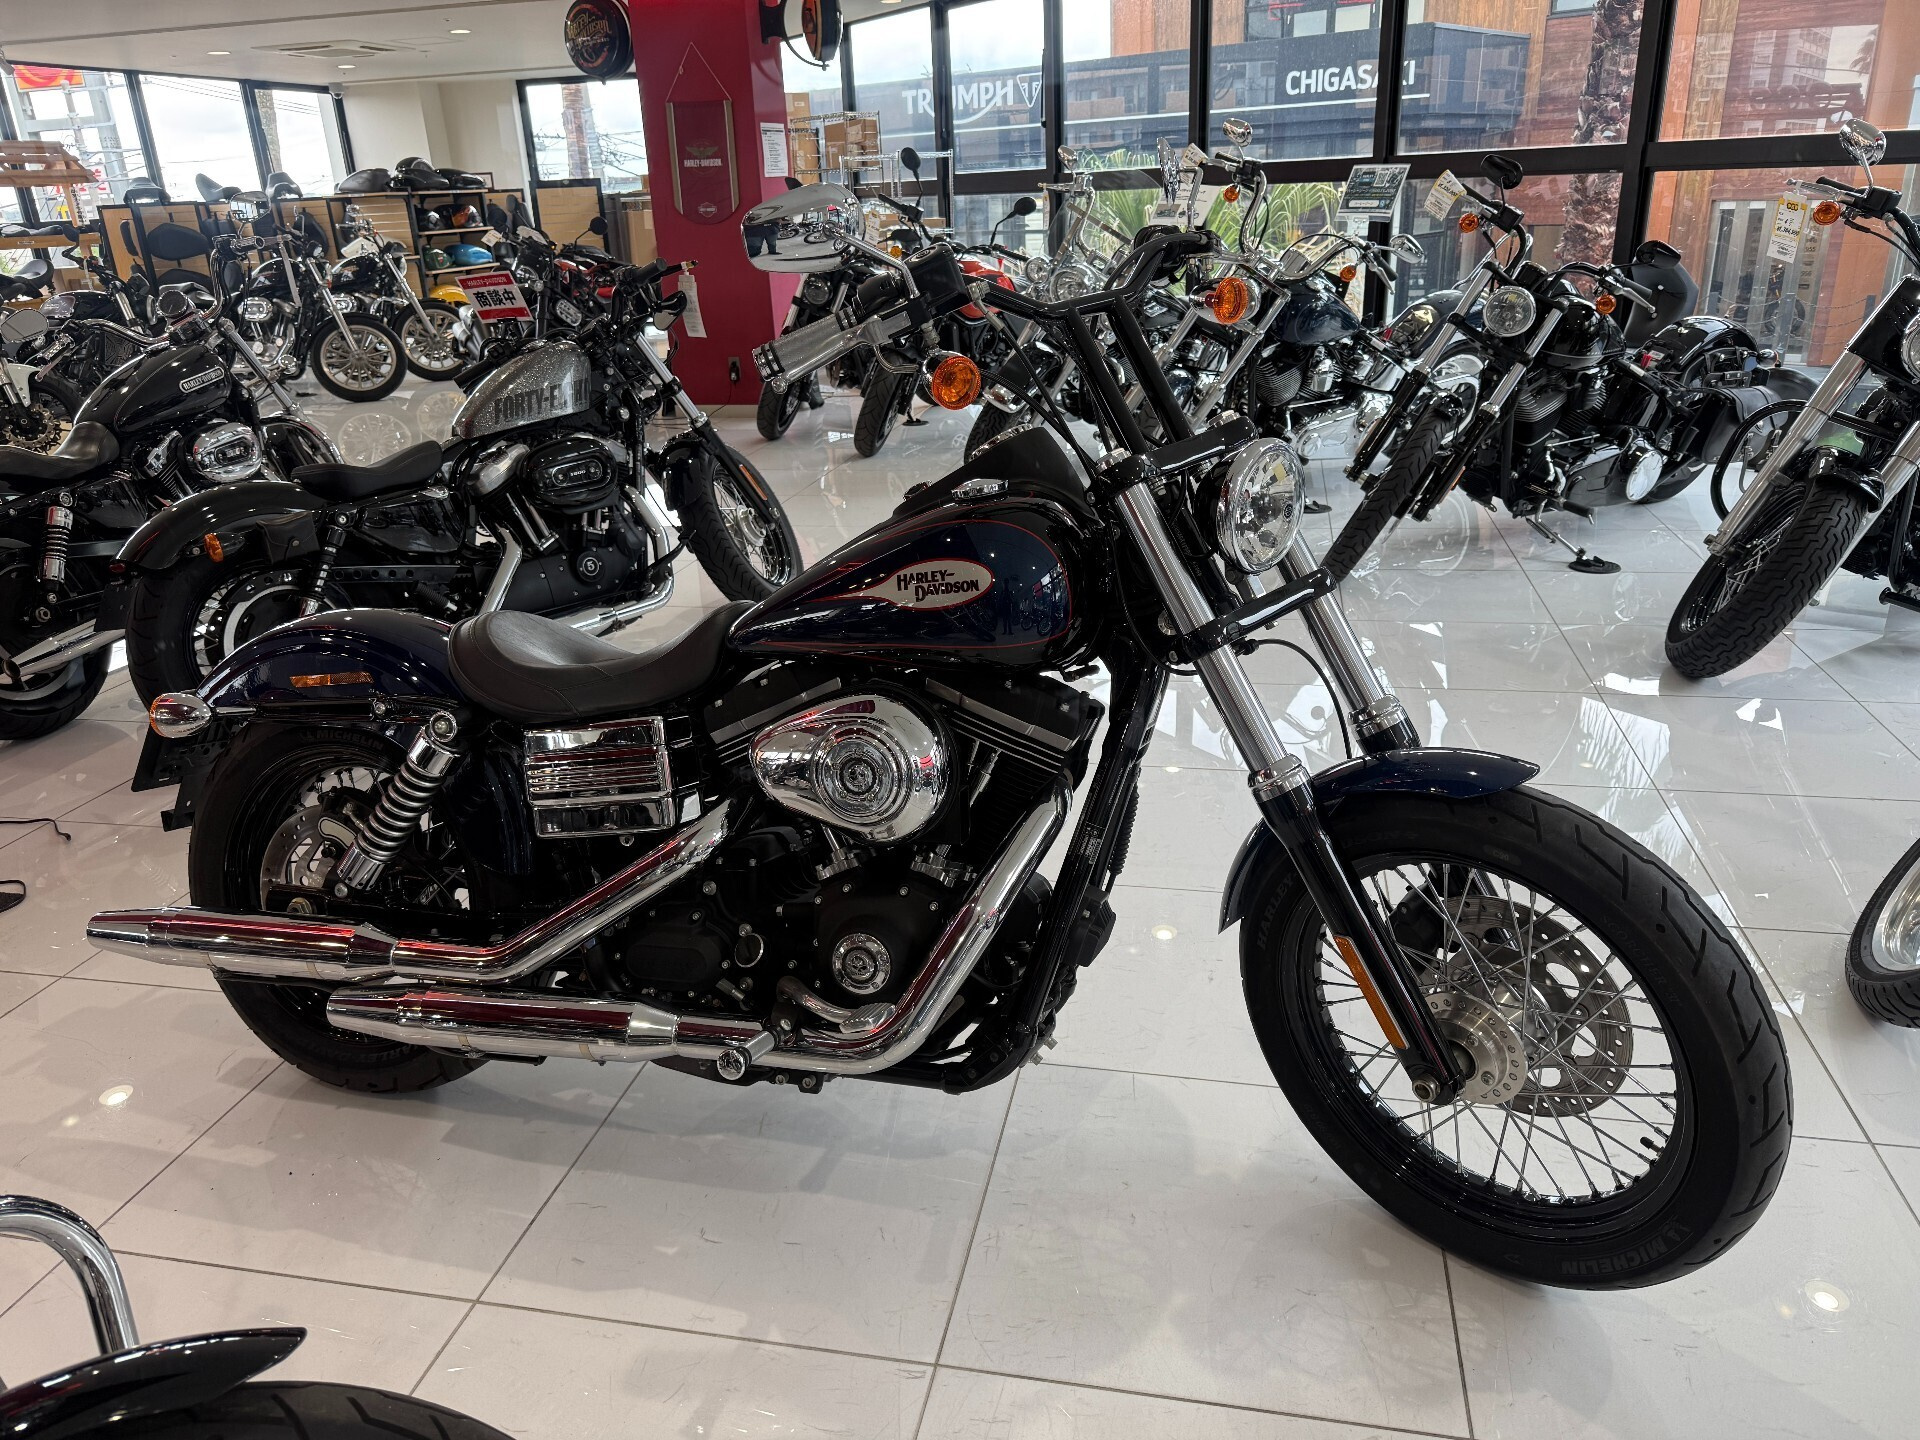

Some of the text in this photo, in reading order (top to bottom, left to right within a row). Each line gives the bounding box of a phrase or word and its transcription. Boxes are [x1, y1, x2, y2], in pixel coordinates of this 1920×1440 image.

[1285, 60, 1416, 95] CHIGASI
[901, 79, 1014, 121] TRMPH
[473, 288, 516, 308] 商談中
[182, 369, 223, 391] HARLEY-DAVIDSON
[914, 579, 980, 602] DAVIDSON
[1561, 1237, 1668, 1275] MICHELIN
